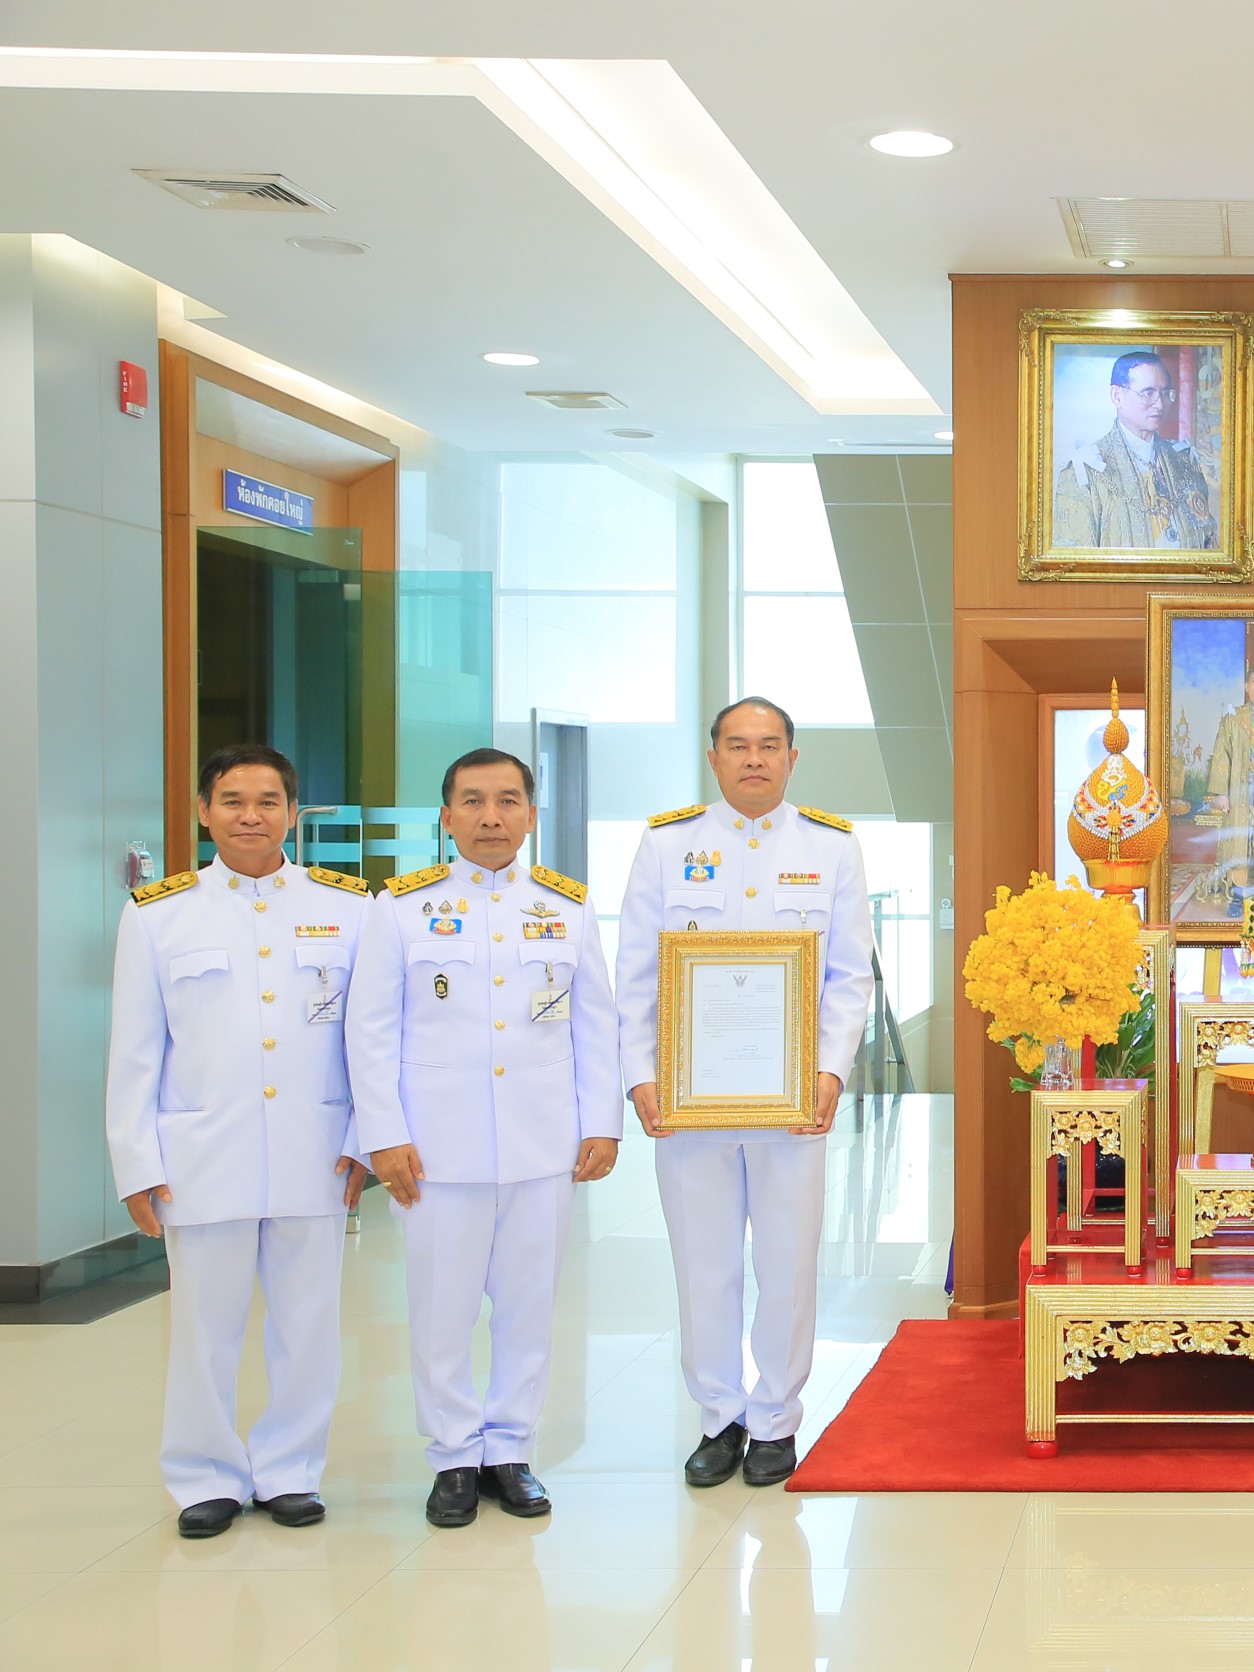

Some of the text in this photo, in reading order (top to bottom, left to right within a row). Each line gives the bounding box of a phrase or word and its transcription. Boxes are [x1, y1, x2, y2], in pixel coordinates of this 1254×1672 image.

[237, 478, 304, 526] ห้องพักคอยใหญ่
